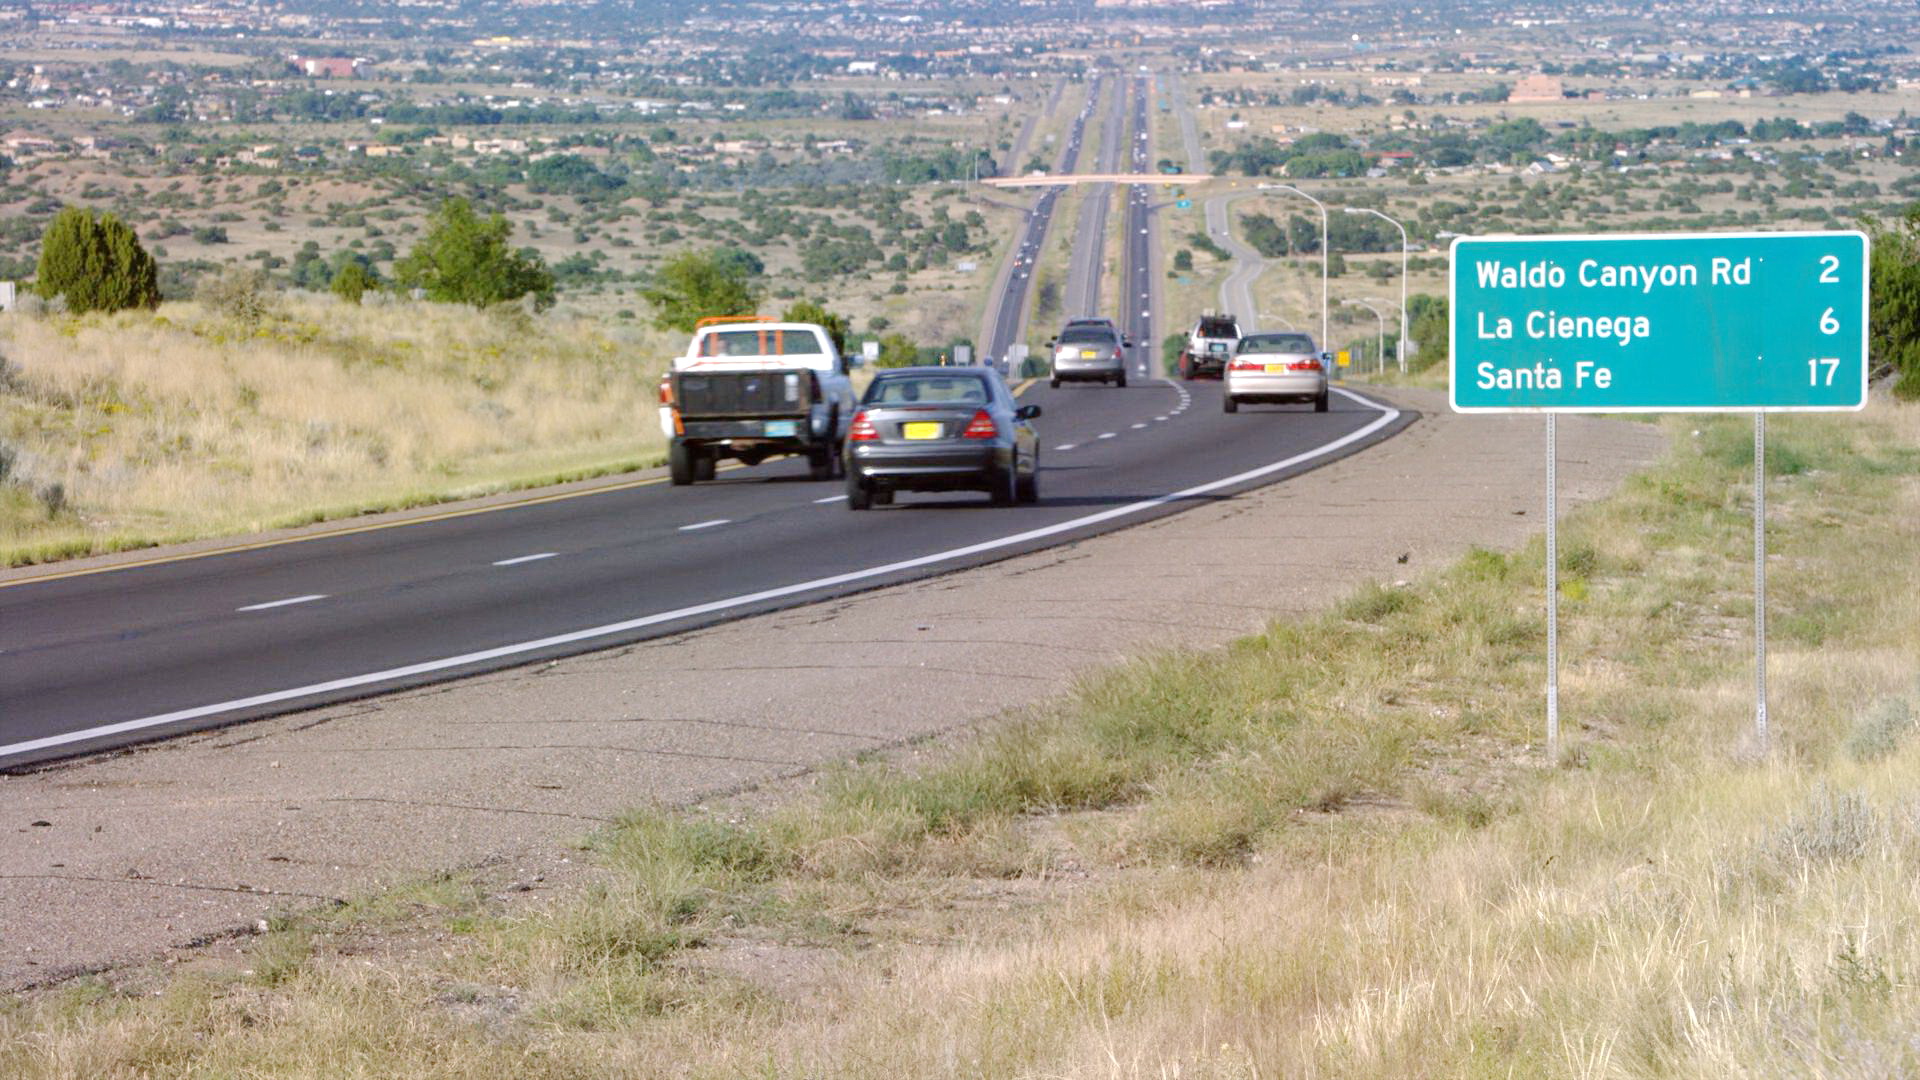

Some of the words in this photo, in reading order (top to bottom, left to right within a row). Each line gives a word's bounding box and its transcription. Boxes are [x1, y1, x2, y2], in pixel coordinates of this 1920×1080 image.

[1476, 260, 1566, 289] Waldo
[1578, 258, 1698, 294] Canyon
[1711, 256, 1751, 286] Rd
[1819, 254, 1840, 284] 2
[1477, 311, 1513, 340] La
[1525, 310, 1650, 347] Cienega
[1819, 306, 1840, 335] 6
[1476, 361, 1563, 390] Santa
[1575, 360, 1612, 389] Fe
[1807, 357, 1841, 387] 17
